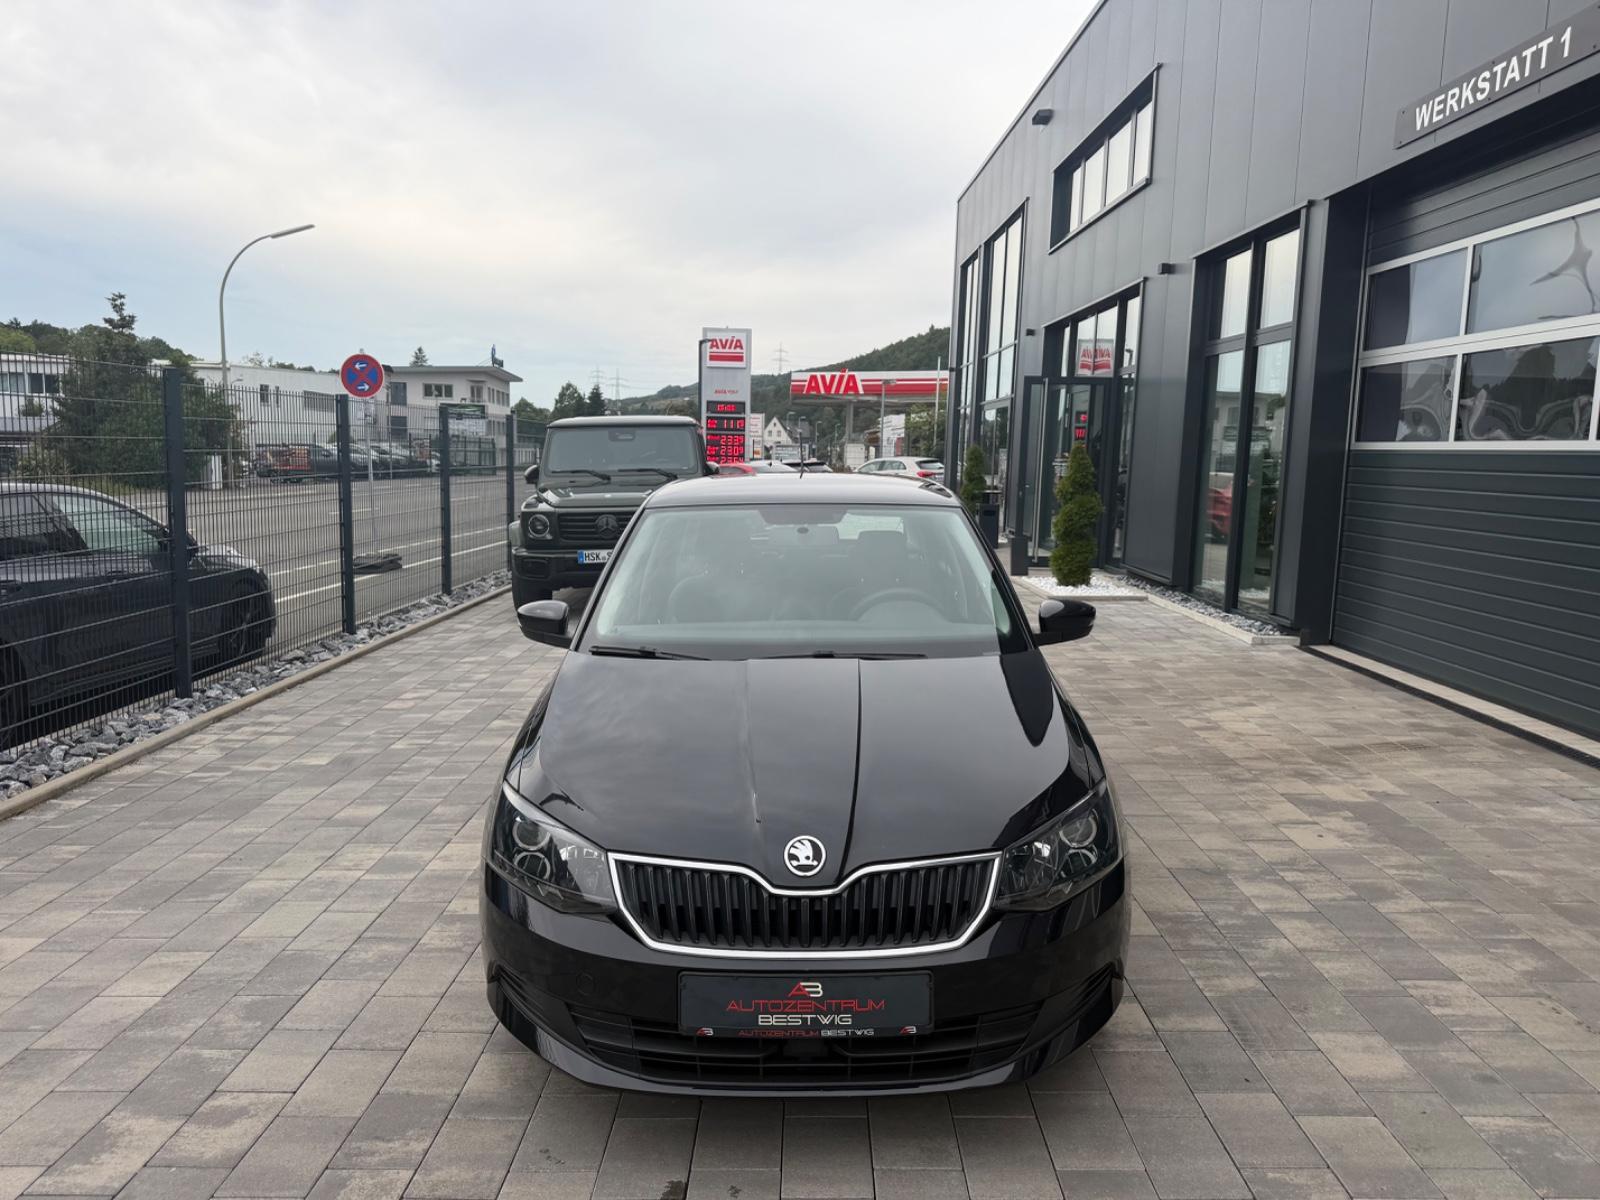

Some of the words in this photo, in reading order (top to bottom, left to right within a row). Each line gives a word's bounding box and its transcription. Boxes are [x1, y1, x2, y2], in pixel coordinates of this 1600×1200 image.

[1415, 36, 1553, 131] WERKSTATT
[1560, 26, 1572, 58] 1
[584, 551, 601, 561] HSK
[726, 1000, 885, 1012] AUTOZENTRUM
[758, 1014, 852, 1026] BESTWIG
[737, 1029, 819, 1038] AUTOZENTRUM
[820, 1028, 875, 1037] BESTWIG
